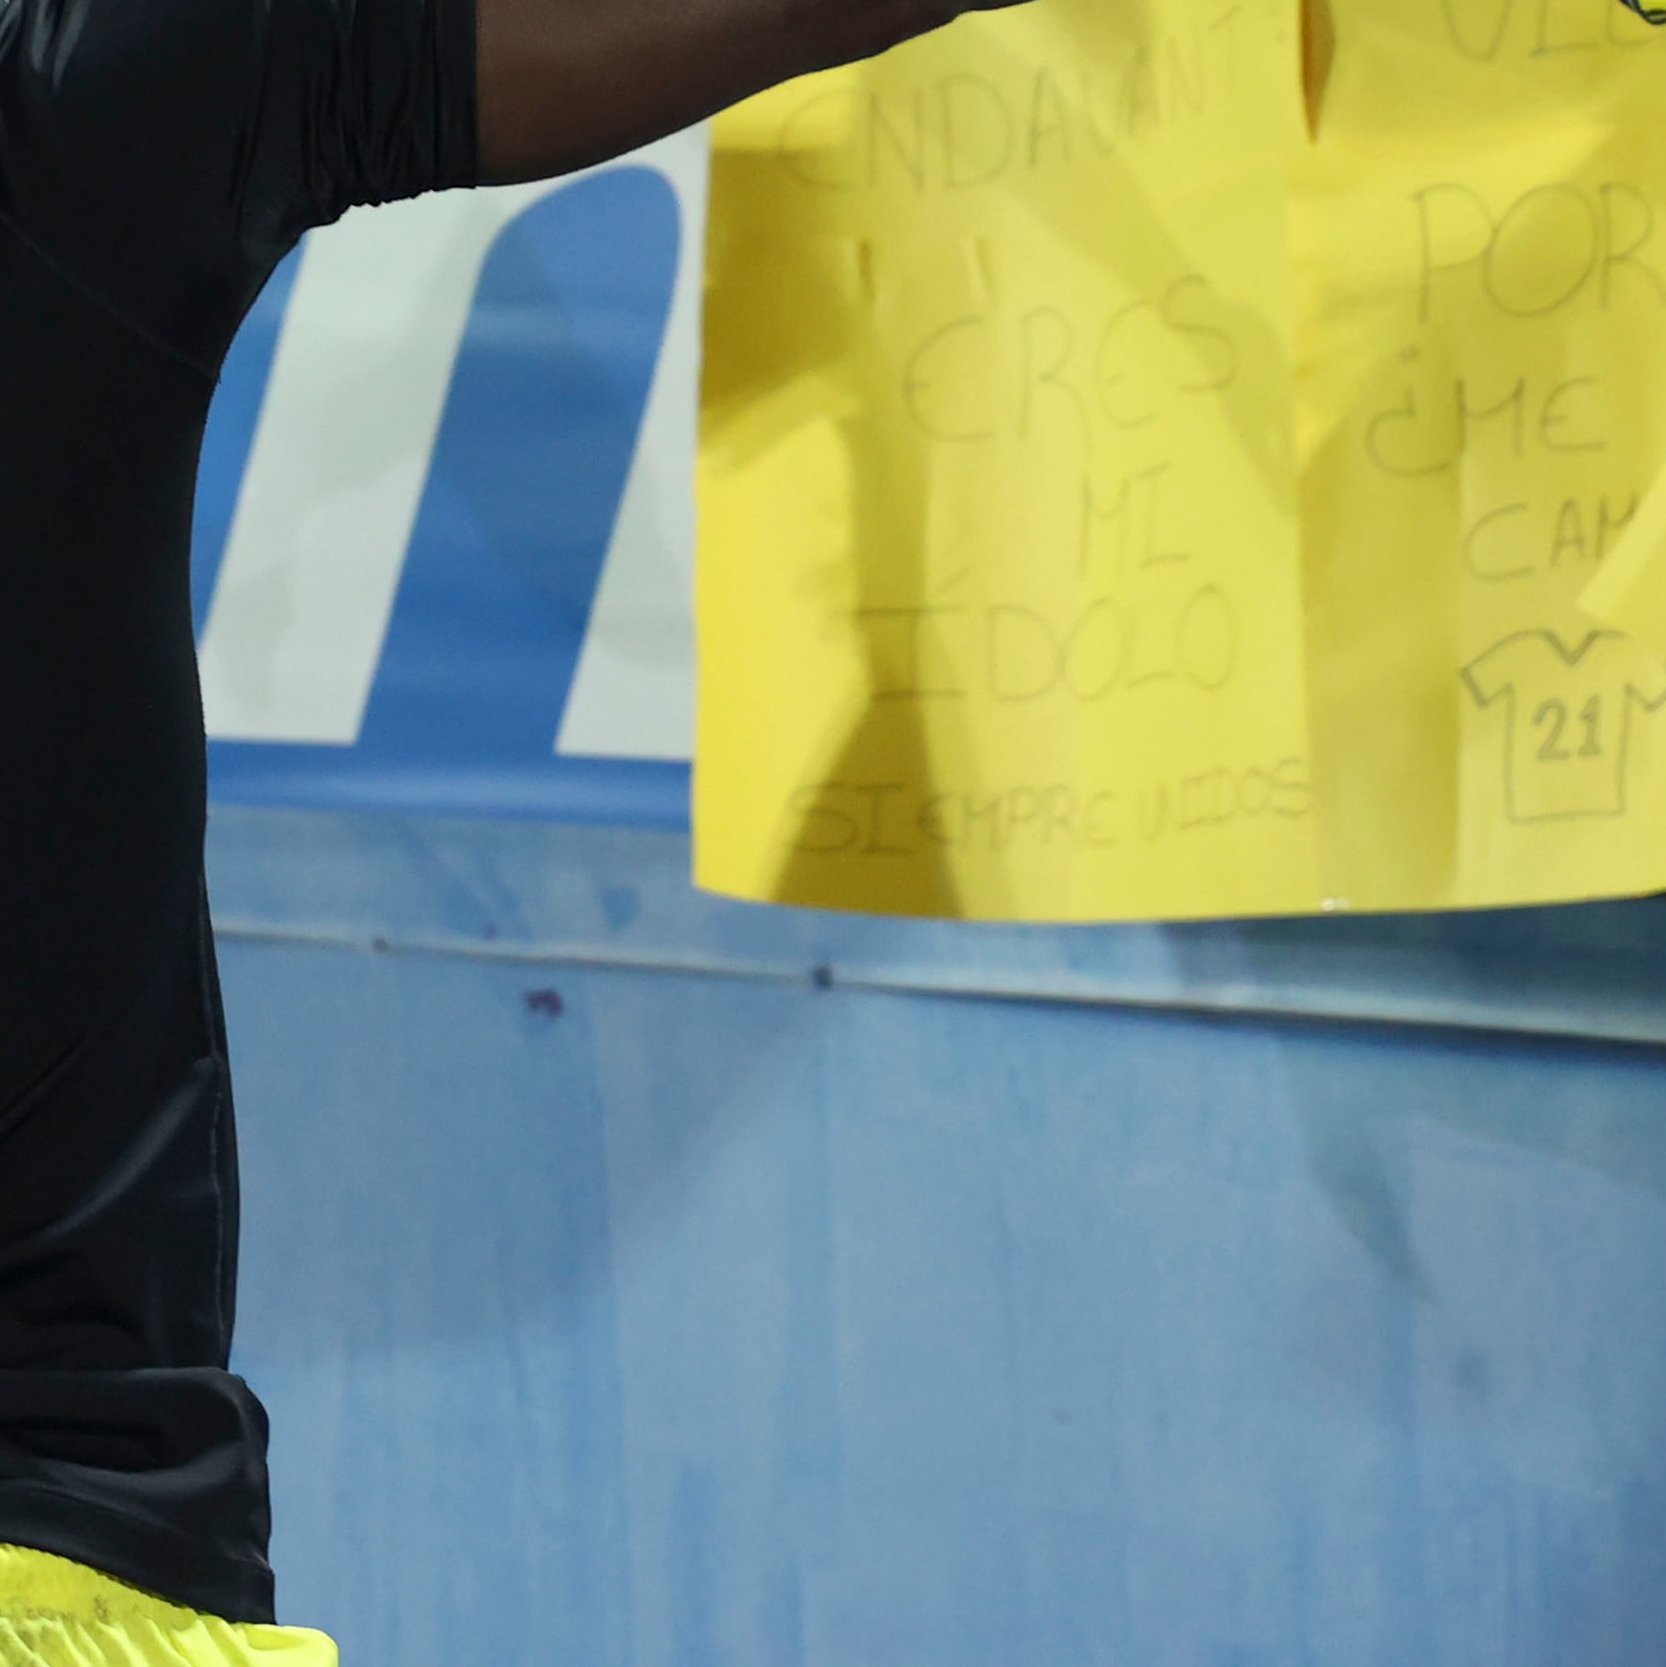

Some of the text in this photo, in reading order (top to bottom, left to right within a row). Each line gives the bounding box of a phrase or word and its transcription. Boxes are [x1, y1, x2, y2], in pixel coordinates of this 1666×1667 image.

[901, 272, 1241, 456] ERES
[1076, 460, 1193, 582] MI
[1530, 694, 1607, 762] 21
